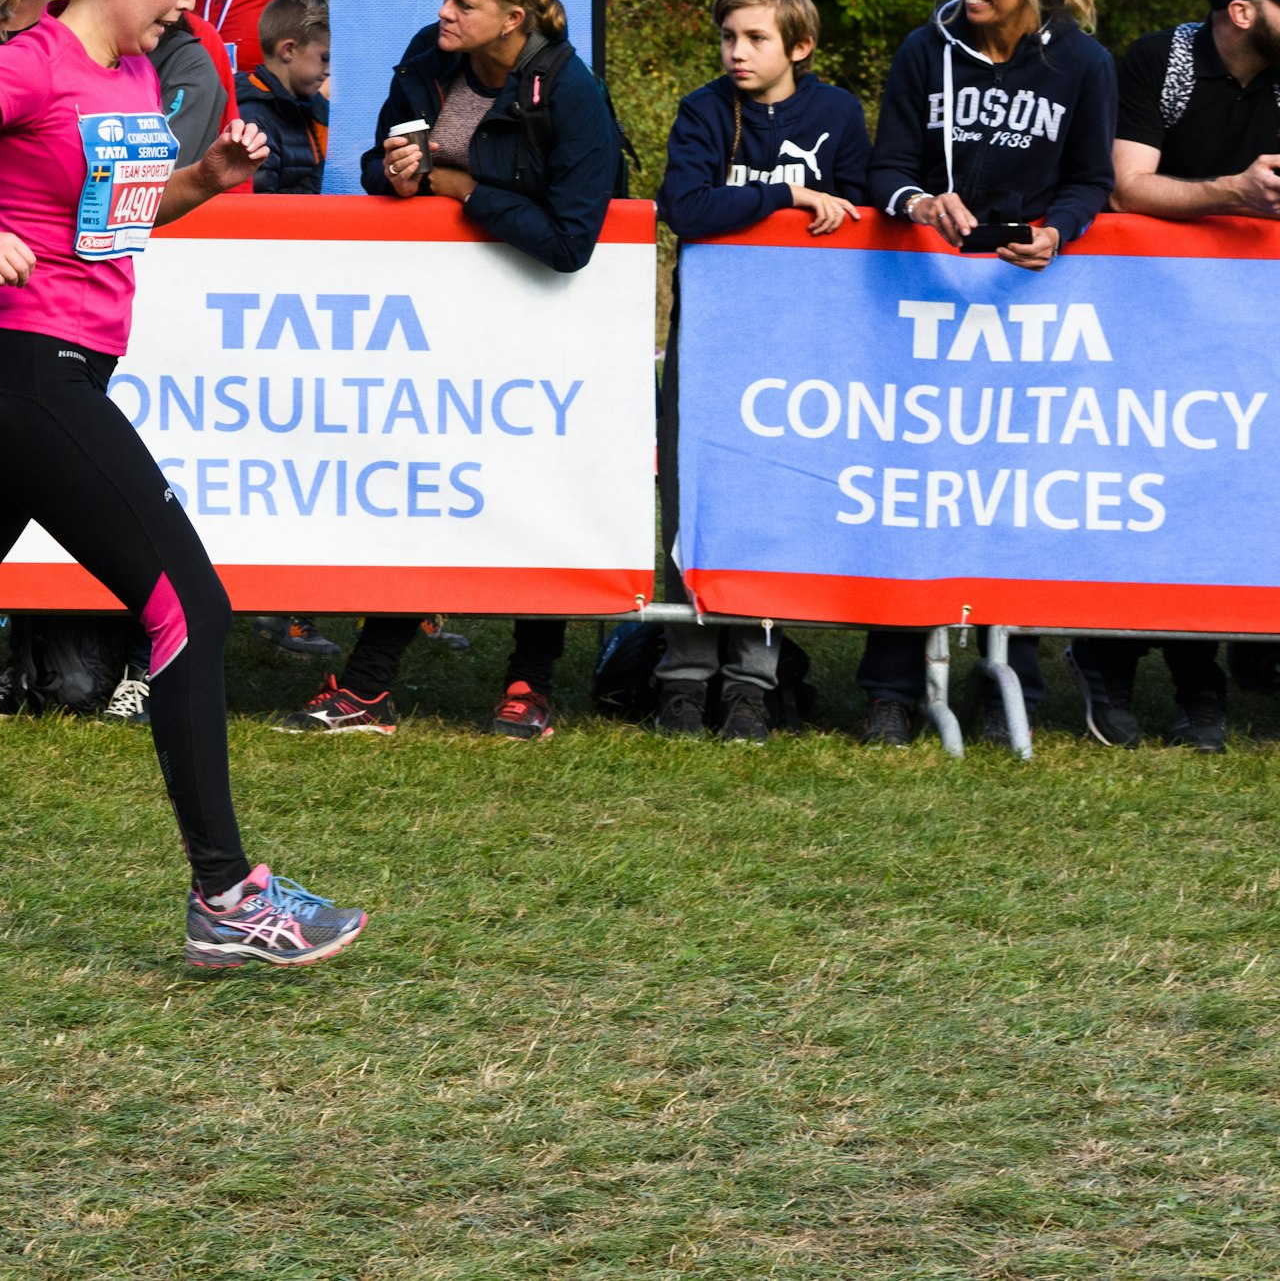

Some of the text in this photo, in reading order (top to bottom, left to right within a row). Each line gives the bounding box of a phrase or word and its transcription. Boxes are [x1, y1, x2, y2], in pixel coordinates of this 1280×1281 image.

[137, 119, 160, 129] TATA
[989, 130, 1033, 149] 1938
[96, 147, 128, 158] TATA
[139, 147, 168, 157] SERVICES
[120, 163, 170, 178] TEAM SPORTIA
[206, 293, 430, 351] TATA
[898, 300, 1113, 362] TATA
[740, 377, 1269, 450] CONSULTANCY
[836, 465, 1166, 533] SERVICES
